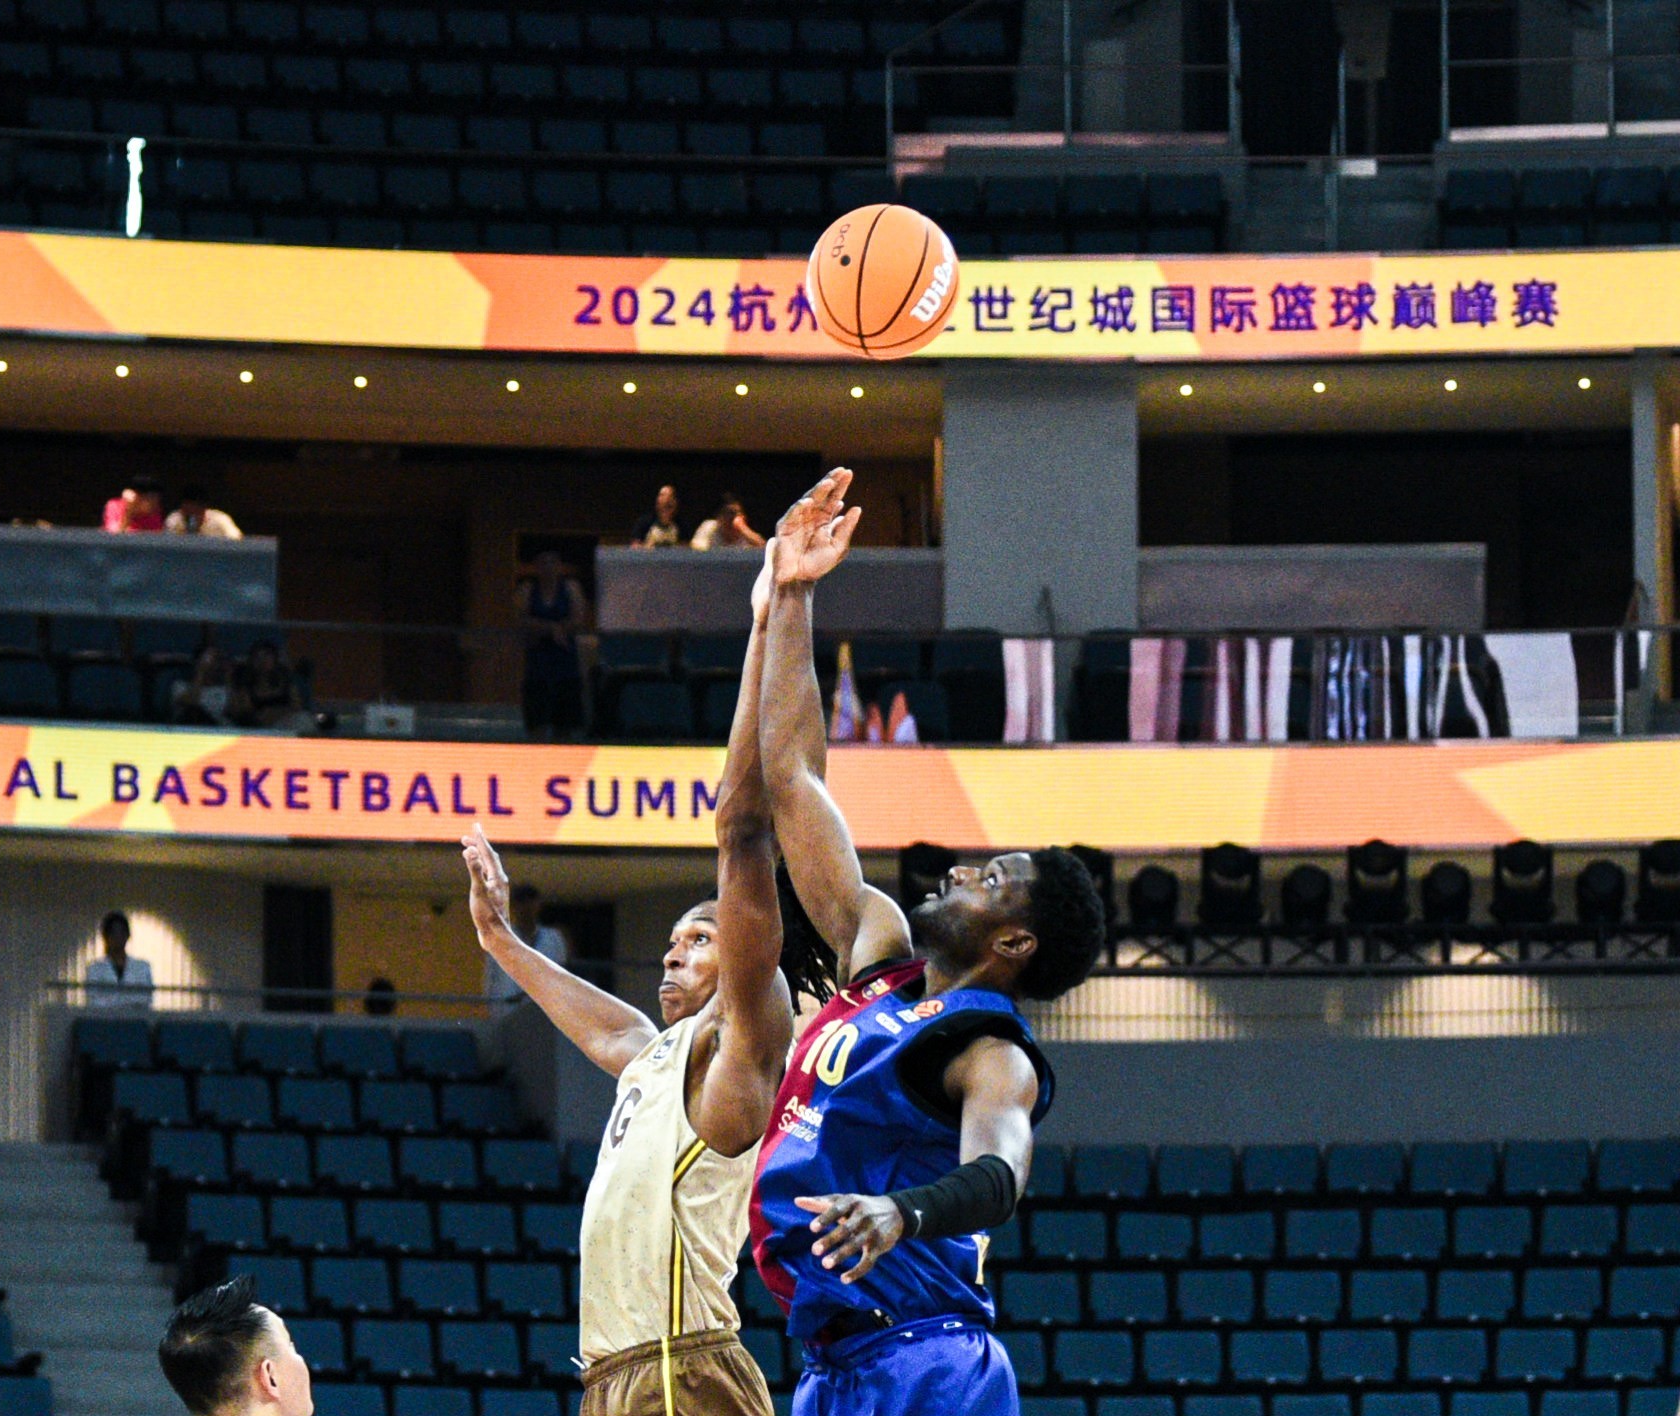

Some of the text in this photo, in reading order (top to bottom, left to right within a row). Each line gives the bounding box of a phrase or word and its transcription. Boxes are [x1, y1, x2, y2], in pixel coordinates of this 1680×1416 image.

[575, 278, 1559, 333] 2024杭州世纪城国际篮球巅峰赛
[111, 763, 513, 816] BASKETBALL
[547, 776, 722, 818] SUMM
[800, 1019, 859, 1086] 10
